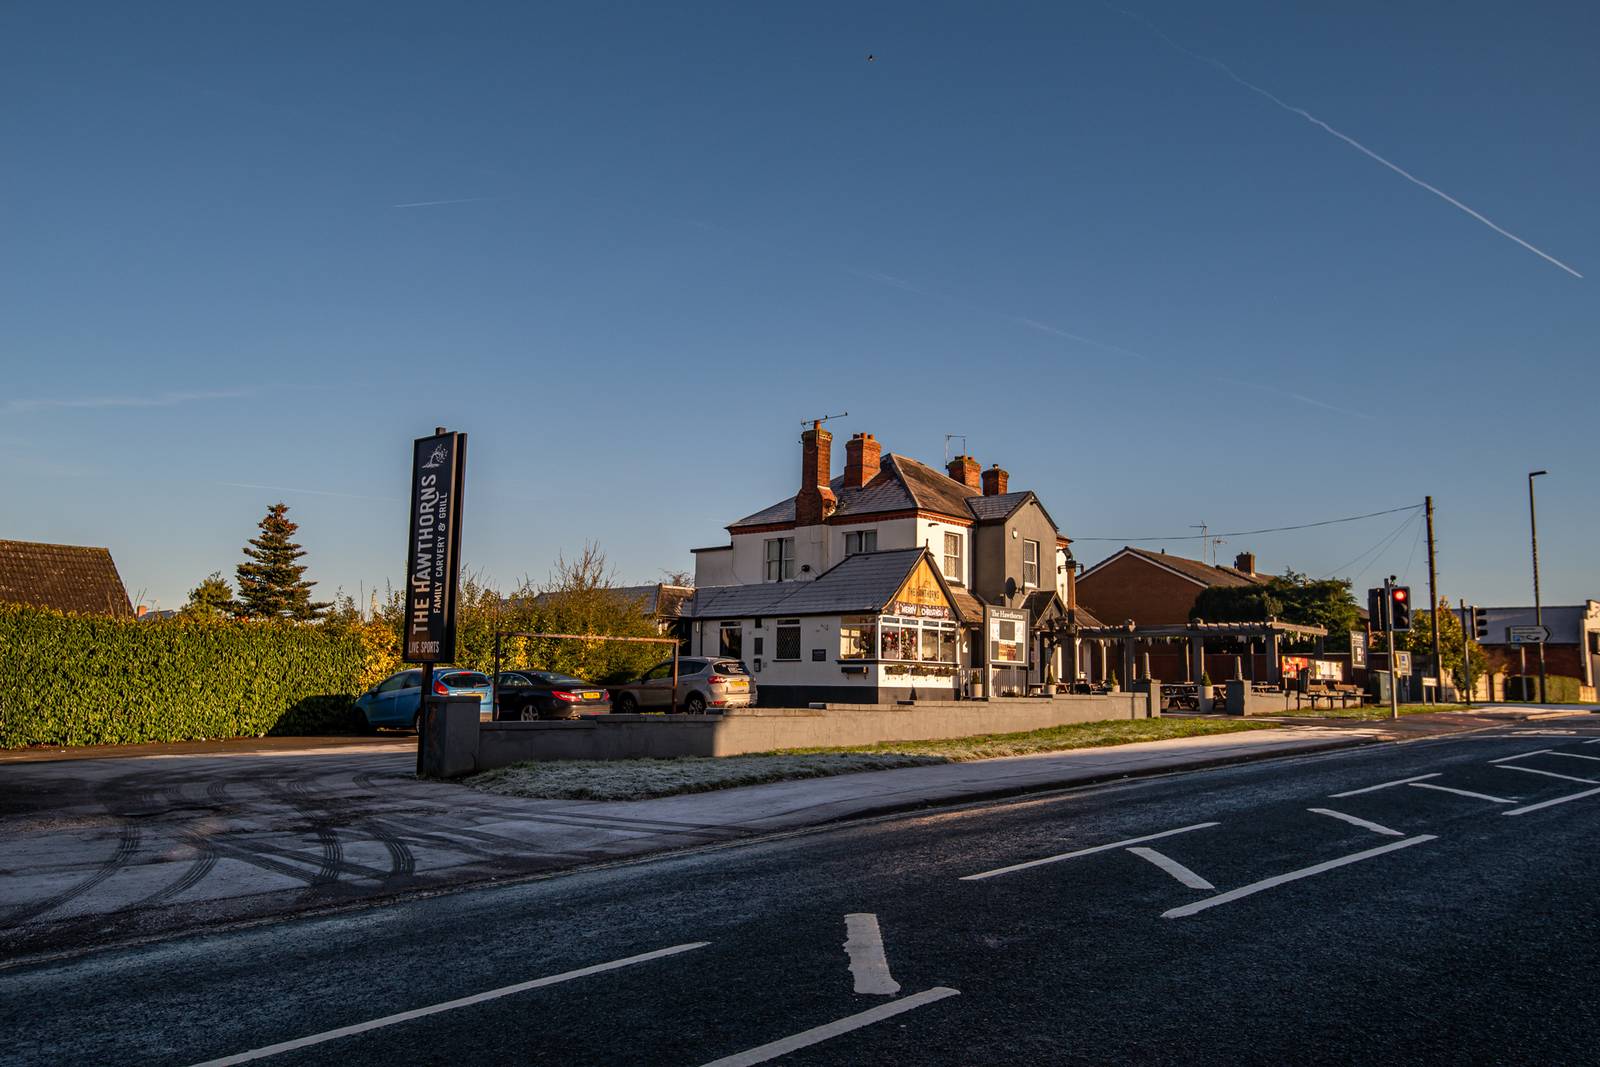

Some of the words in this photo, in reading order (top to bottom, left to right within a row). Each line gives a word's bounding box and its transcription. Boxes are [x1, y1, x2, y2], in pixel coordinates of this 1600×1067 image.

[439, 492, 448, 519] GRILL
[411, 474, 439, 593] HAWTHORNS
[438, 523, 446, 532] &
[435, 536, 446, 577] CARVERY
[433, 582, 443, 614] FAMILY
[901, 603, 917, 616] MERRY
[413, 597, 430, 635] THE
[991, 609, 999, 618] The
[1000, 610, 1024, 620] Hawthorns
[408, 641, 420, 654] LIVE
[421, 640, 440, 654] SPORTS
